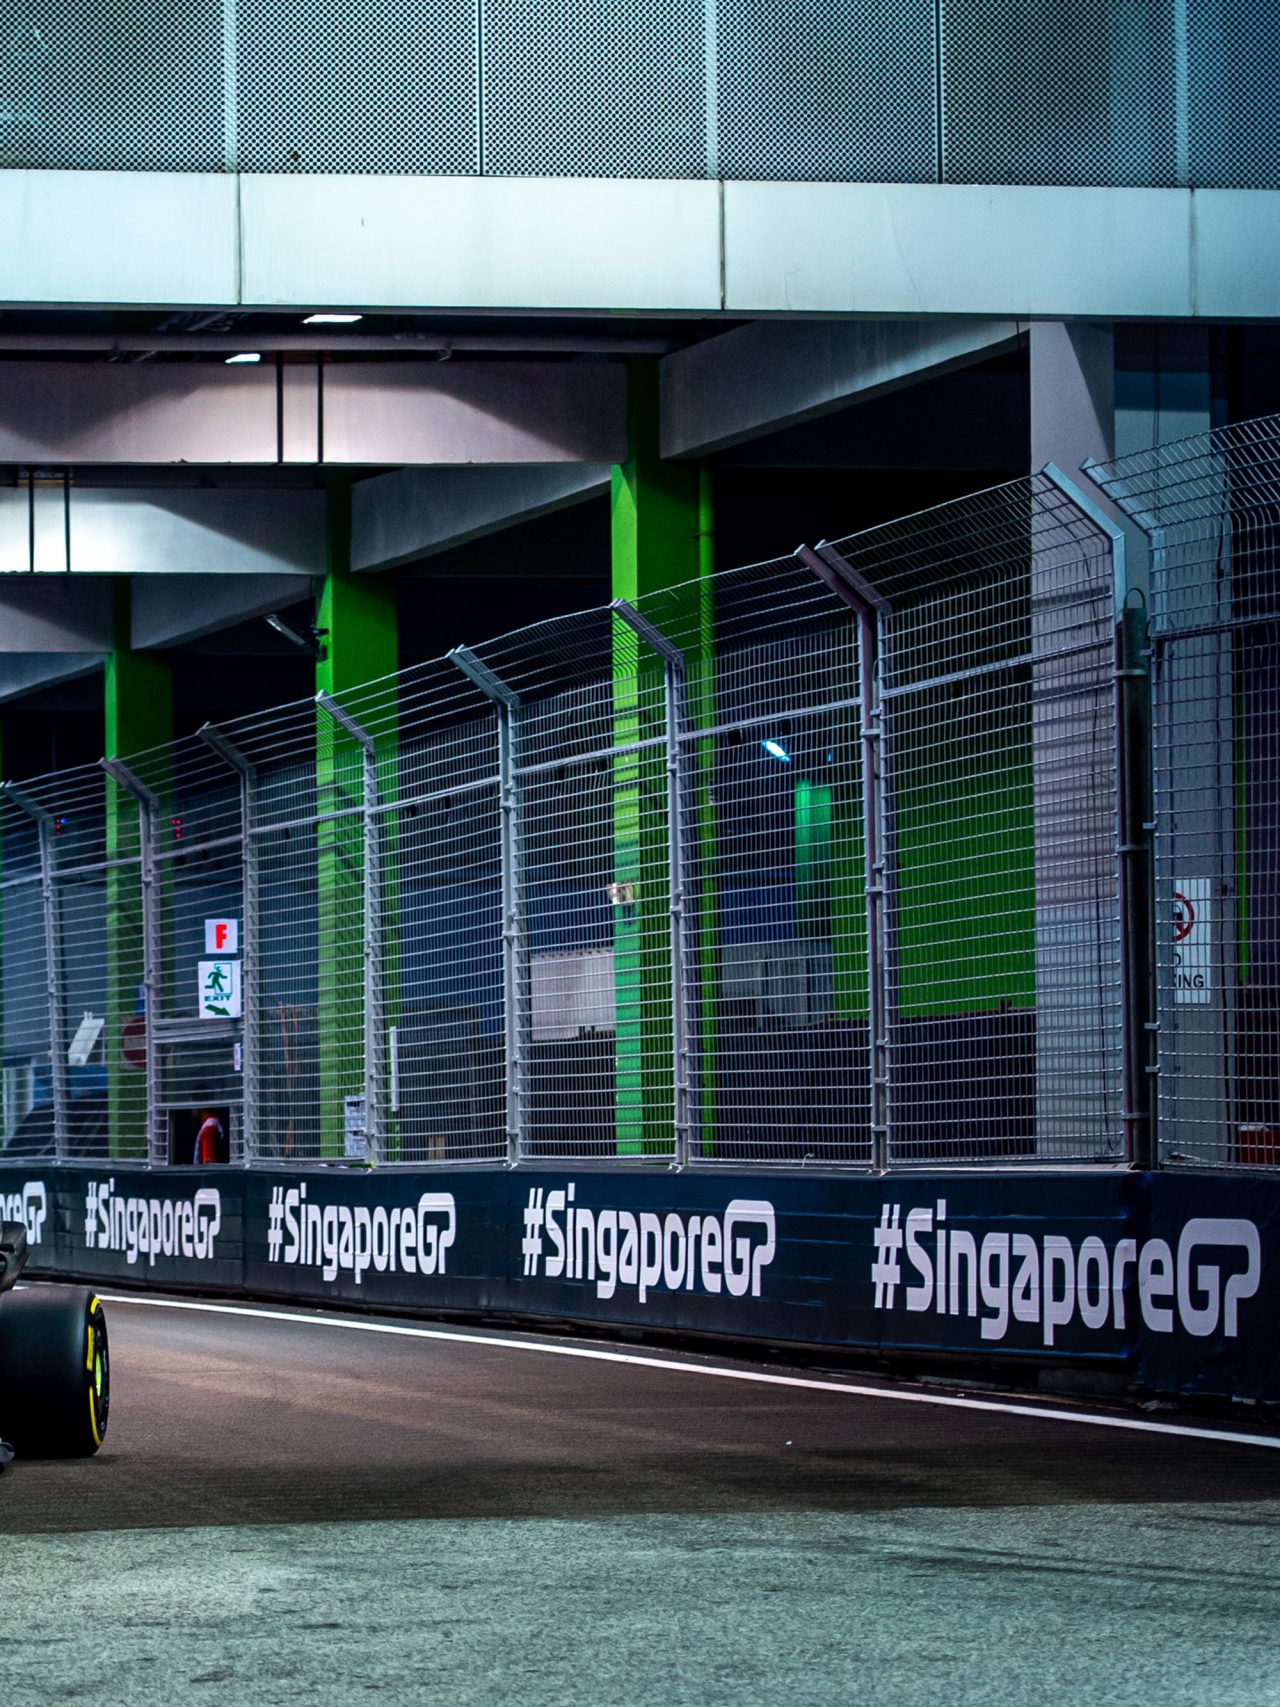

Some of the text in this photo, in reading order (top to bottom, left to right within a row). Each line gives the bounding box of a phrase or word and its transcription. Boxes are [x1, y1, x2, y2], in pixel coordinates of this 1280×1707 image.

[215, 924, 228, 949] F
[204, 994, 232, 1002] EXIT
[85, 1178, 221, 1266] #SingaporeGP
[268, 1182, 456, 1284] #SingaporeGP
[522, 1182, 776, 1303] #SingaporeGP
[871, 1199, 1261, 1346] #SingaporeGP
